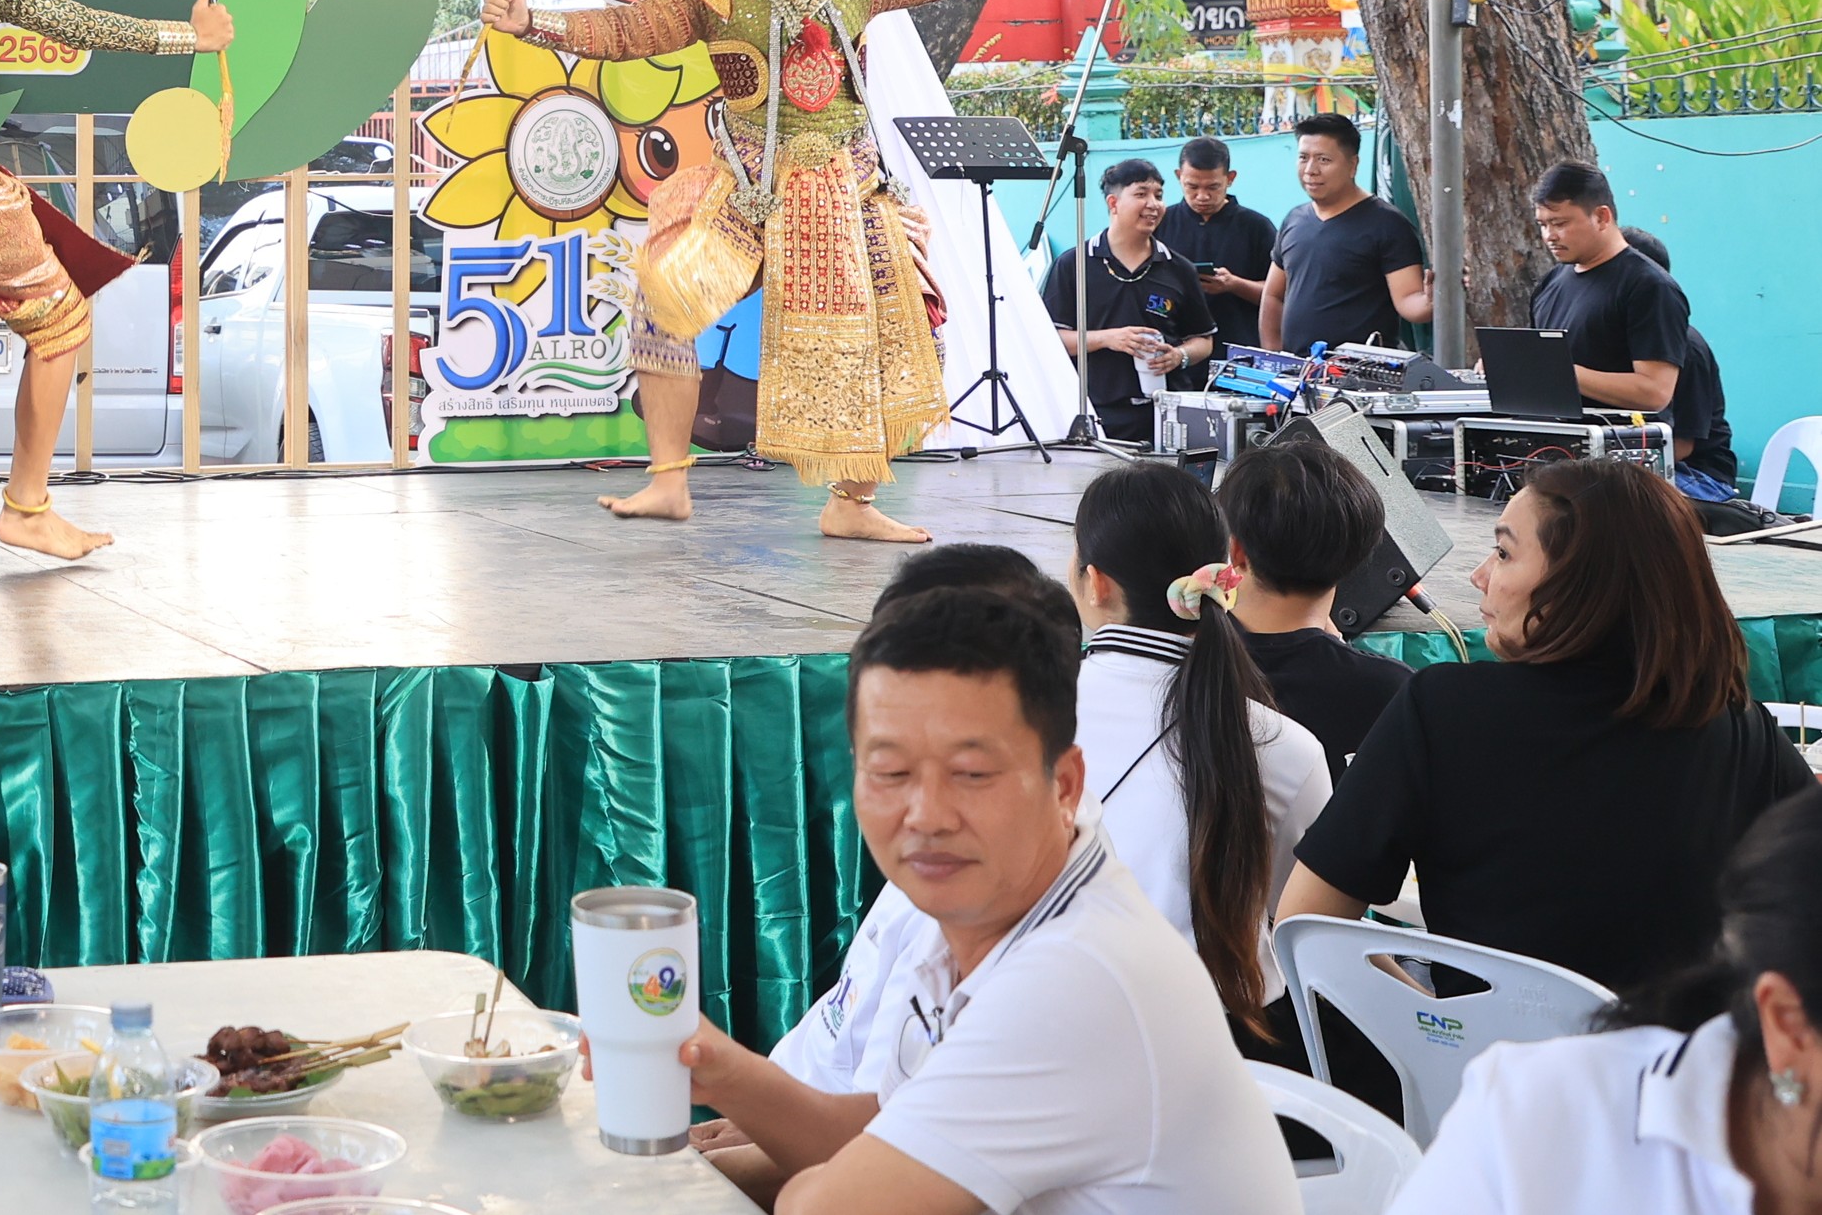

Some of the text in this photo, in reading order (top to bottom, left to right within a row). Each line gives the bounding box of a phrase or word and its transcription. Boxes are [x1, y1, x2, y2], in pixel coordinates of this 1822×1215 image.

[436, 234, 596, 390] 51
[528, 339, 607, 361] ALRO
[438, 395, 614, 414] สร้างสิทธิ เสริมทุน หนุนเกษตร
[643, 966, 675, 998] 49
[1416, 1011, 1463, 1030] CNP
